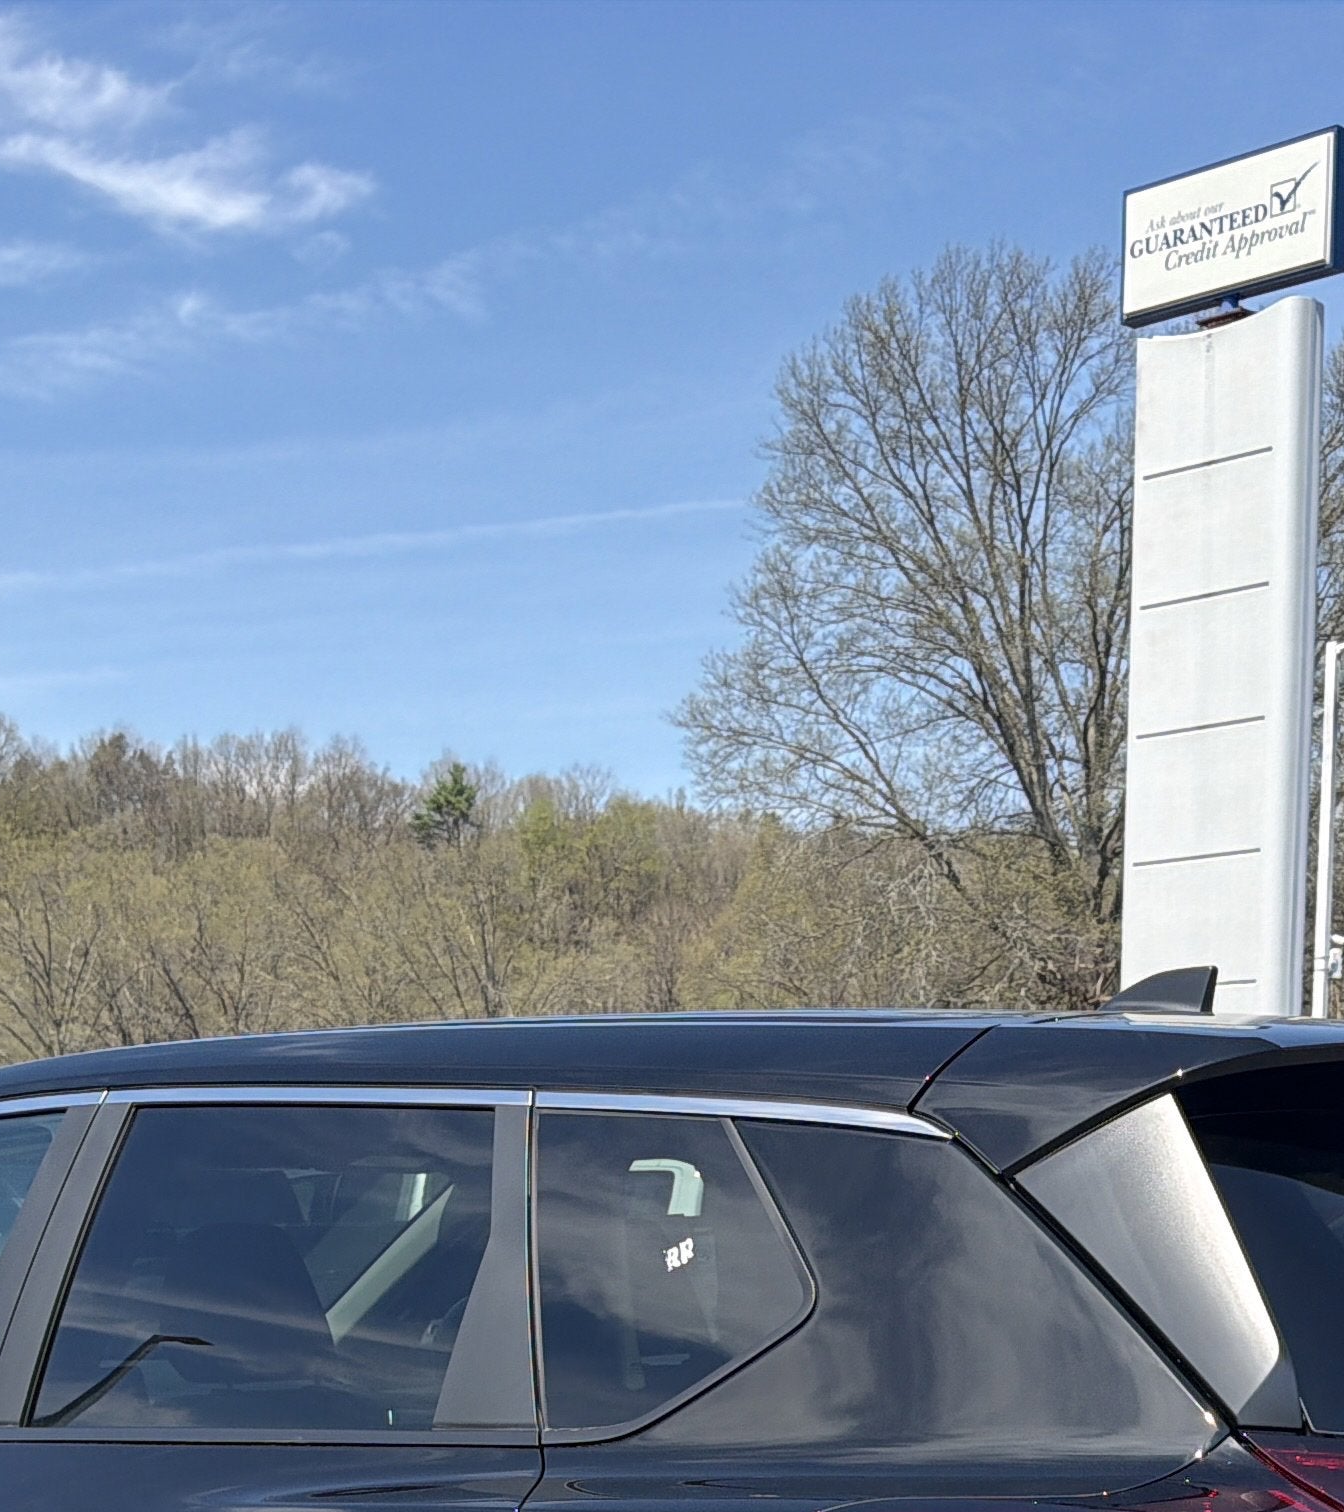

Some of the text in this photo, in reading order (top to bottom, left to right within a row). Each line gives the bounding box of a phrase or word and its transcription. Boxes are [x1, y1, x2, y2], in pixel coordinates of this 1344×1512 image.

[1129, 203, 1268, 259] GUARANTEED
[1145, 202, 1225, 234] Ask about our
[1164, 211, 1308, 271] Credit Approval
